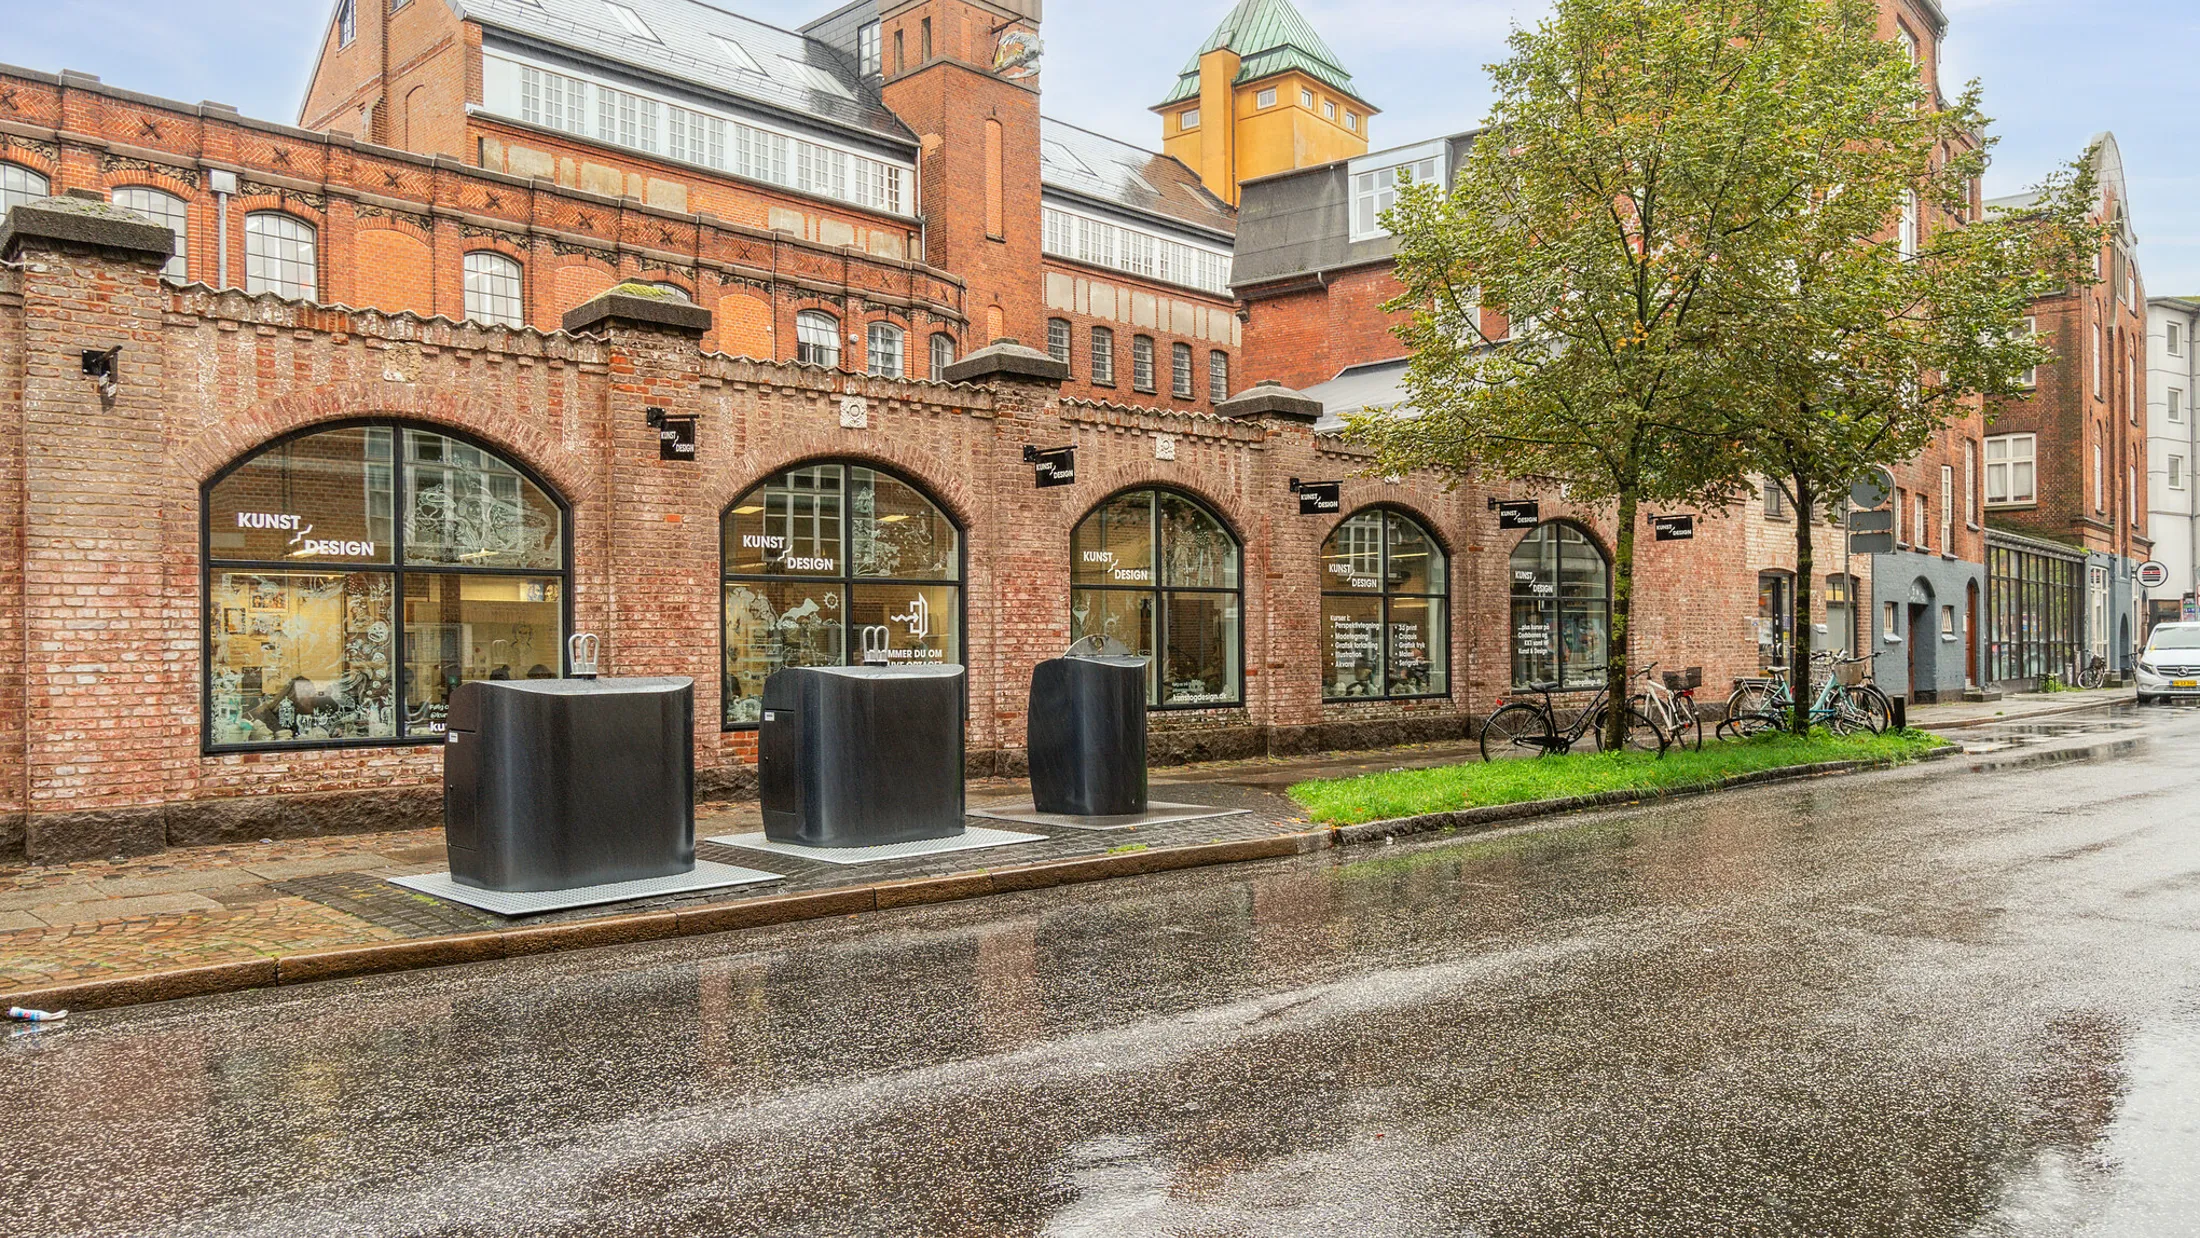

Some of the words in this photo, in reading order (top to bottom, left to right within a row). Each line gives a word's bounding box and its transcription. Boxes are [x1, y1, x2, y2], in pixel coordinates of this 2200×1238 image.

[661, 431, 676, 439] KUNST
[675, 444, 694, 452] DESIGN
[1036, 462, 1053, 471] KUNST
[1053, 470, 1073, 479] DESIGN
[237, 512, 301, 530] KUNST
[742, 534, 785, 549] KUNST
[304, 539, 375, 556] DESIGN
[1083, 551, 1113, 562] KUNST
[787, 557, 834, 571] DESIGN
[1329, 564, 1351, 573] KUNST
[1114, 569, 1148, 581] DESIGN
[1514, 570, 1533, 580] KUNST
[1351, 577, 1377, 588] DESIGN
[1532, 584, 1554, 593] DESIGN
[913, 649, 926, 658] DU
[928, 649, 943, 658] OM
